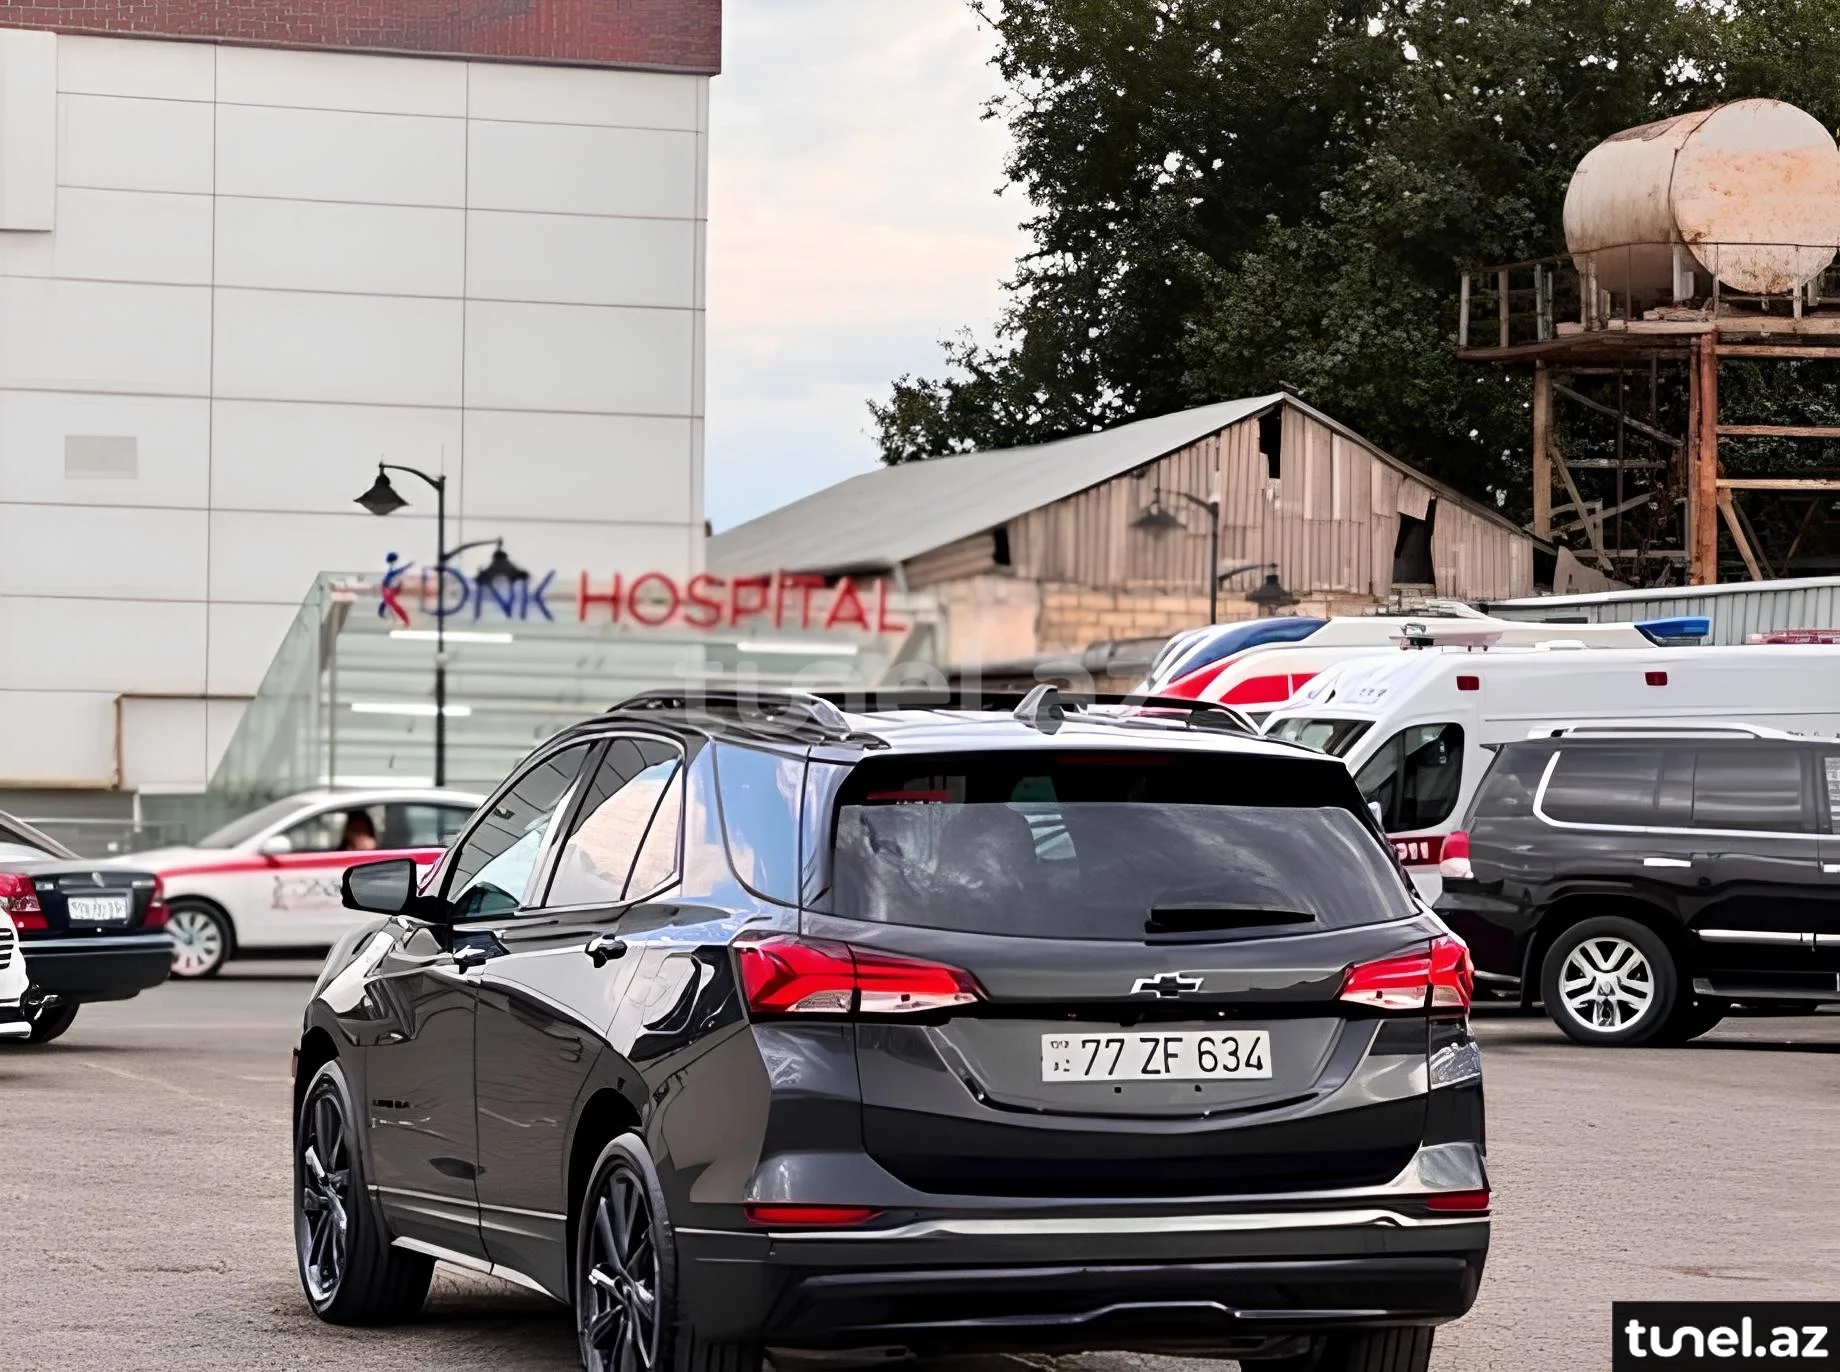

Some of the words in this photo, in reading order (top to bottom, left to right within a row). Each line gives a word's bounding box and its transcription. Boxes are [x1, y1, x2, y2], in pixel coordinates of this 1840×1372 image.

[420, 567, 556, 623] DNK
[578, 570, 907, 633] HOSPITAL
[1082, 1038, 1125, 1076] 77
[1139, 1037, 1183, 1074] ZF
[1197, 1036, 1263, 1073] 634
